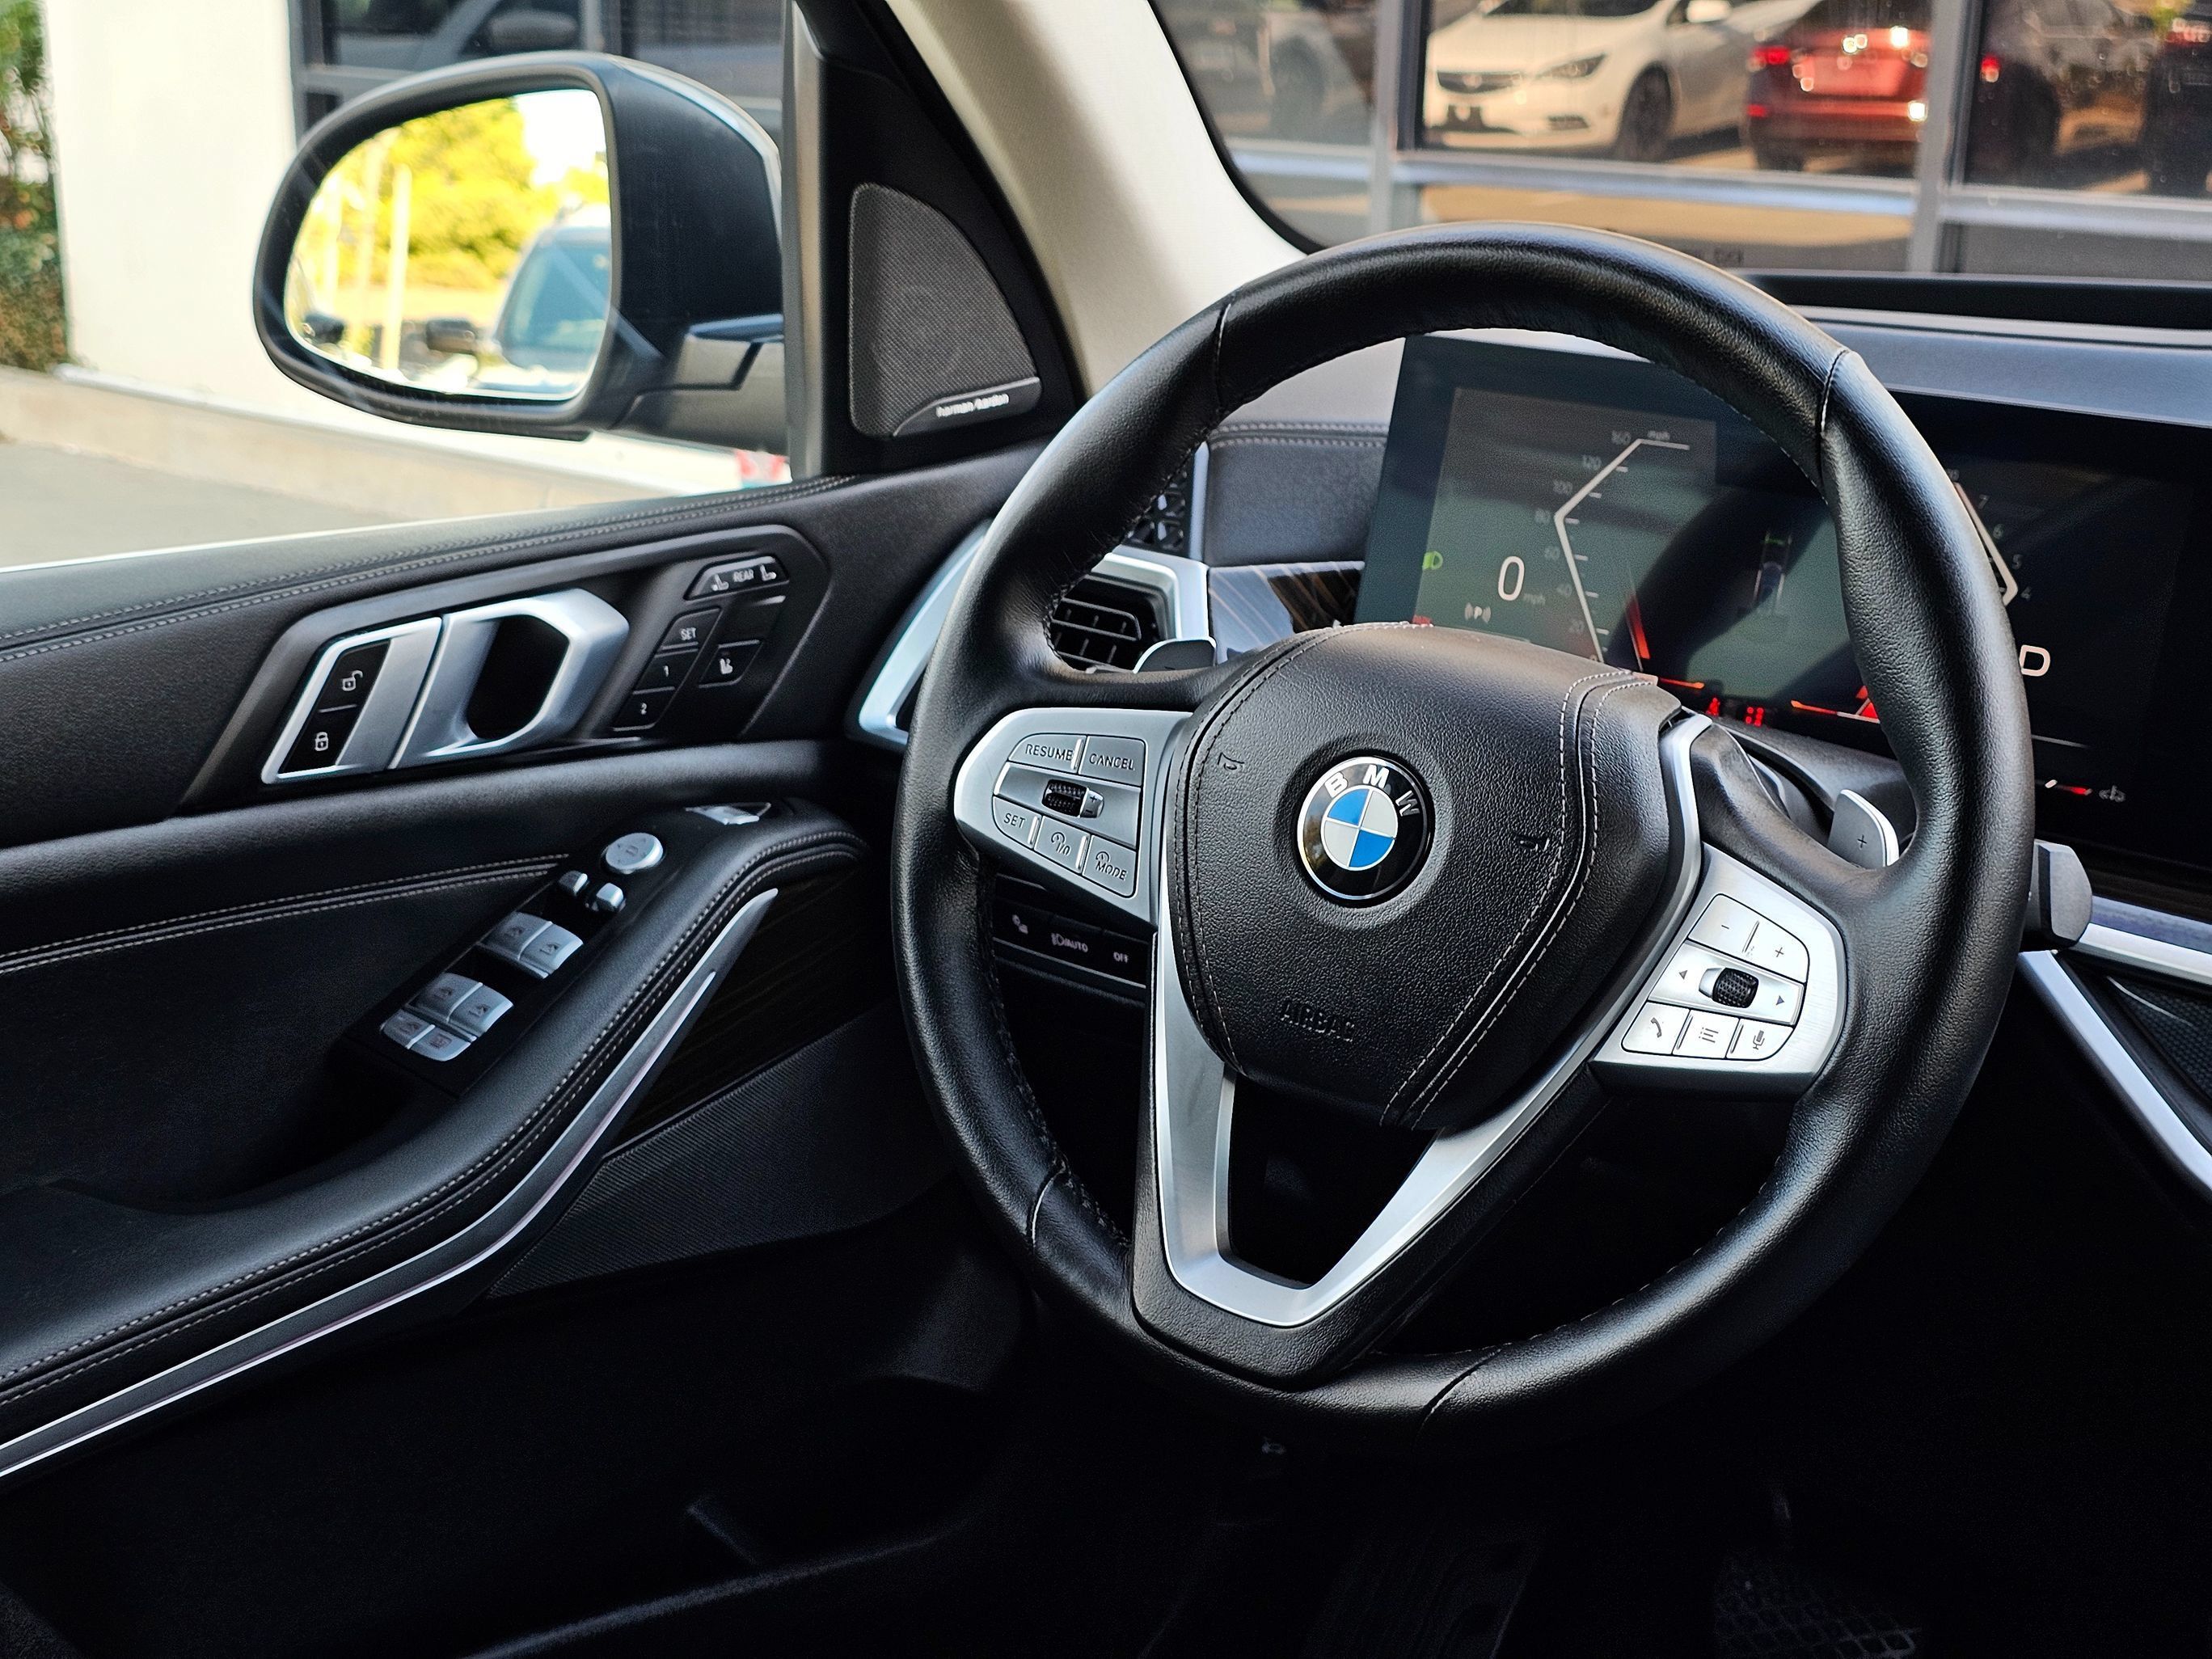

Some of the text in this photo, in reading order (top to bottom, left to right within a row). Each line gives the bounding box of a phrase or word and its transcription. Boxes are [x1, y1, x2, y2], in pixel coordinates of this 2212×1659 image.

[732, 568, 754, 583] REAR
[1498, 555, 1525, 602] 0
[680, 627, 697, 641] SET
[663, 665, 669, 678] 1
[1024, 743, 1074, 762] RESUME
[1089, 753, 1136, 771] CANCEL
[1324, 764, 1420, 817] BMW
[1003, 813, 1026, 830] SET
[1095, 860, 1128, 881] MODE
